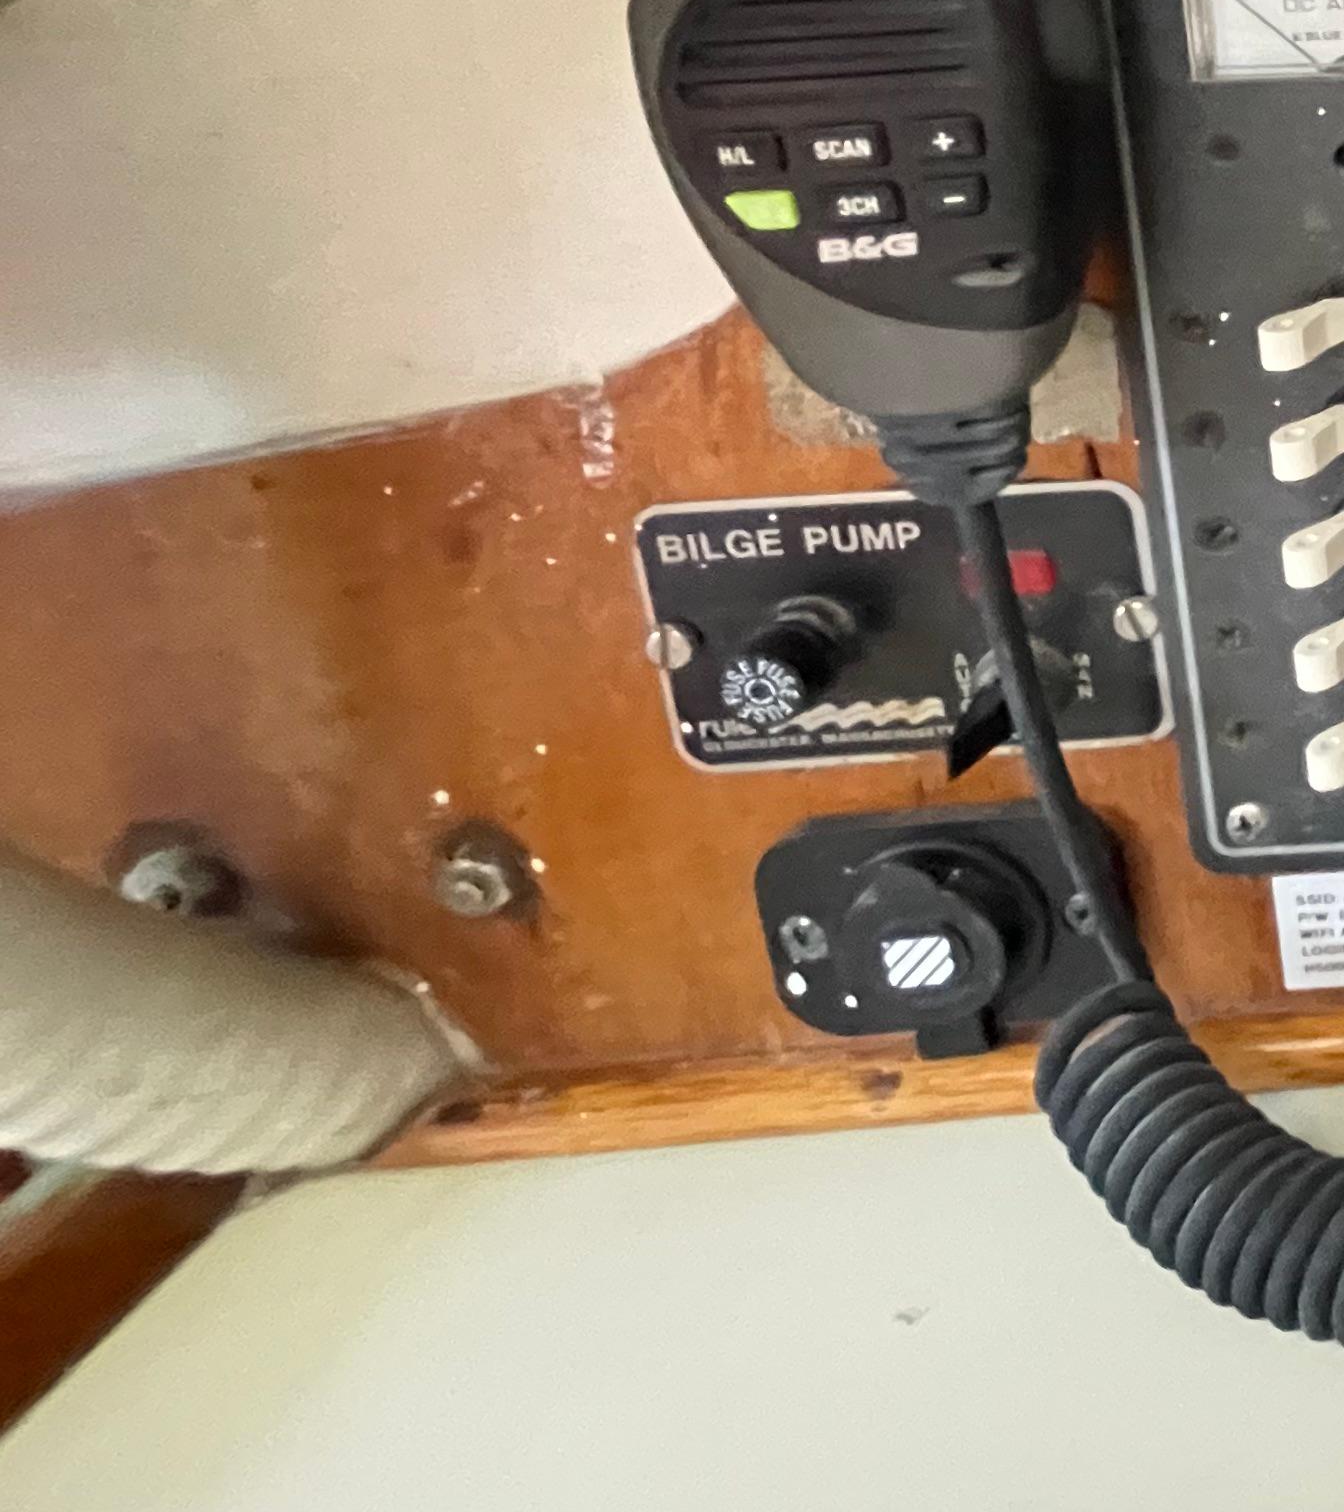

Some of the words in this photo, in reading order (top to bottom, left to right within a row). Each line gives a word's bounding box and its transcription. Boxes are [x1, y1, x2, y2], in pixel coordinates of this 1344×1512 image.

[718, 147, 754, 165] H/L
[814, 139, 871, 160] SCAN
[838, 196, 880, 216] 3CH
[818, 232, 917, 263] B&G
[657, 529, 784, 568] BILGE
[803, 521, 920, 554] PUMP
